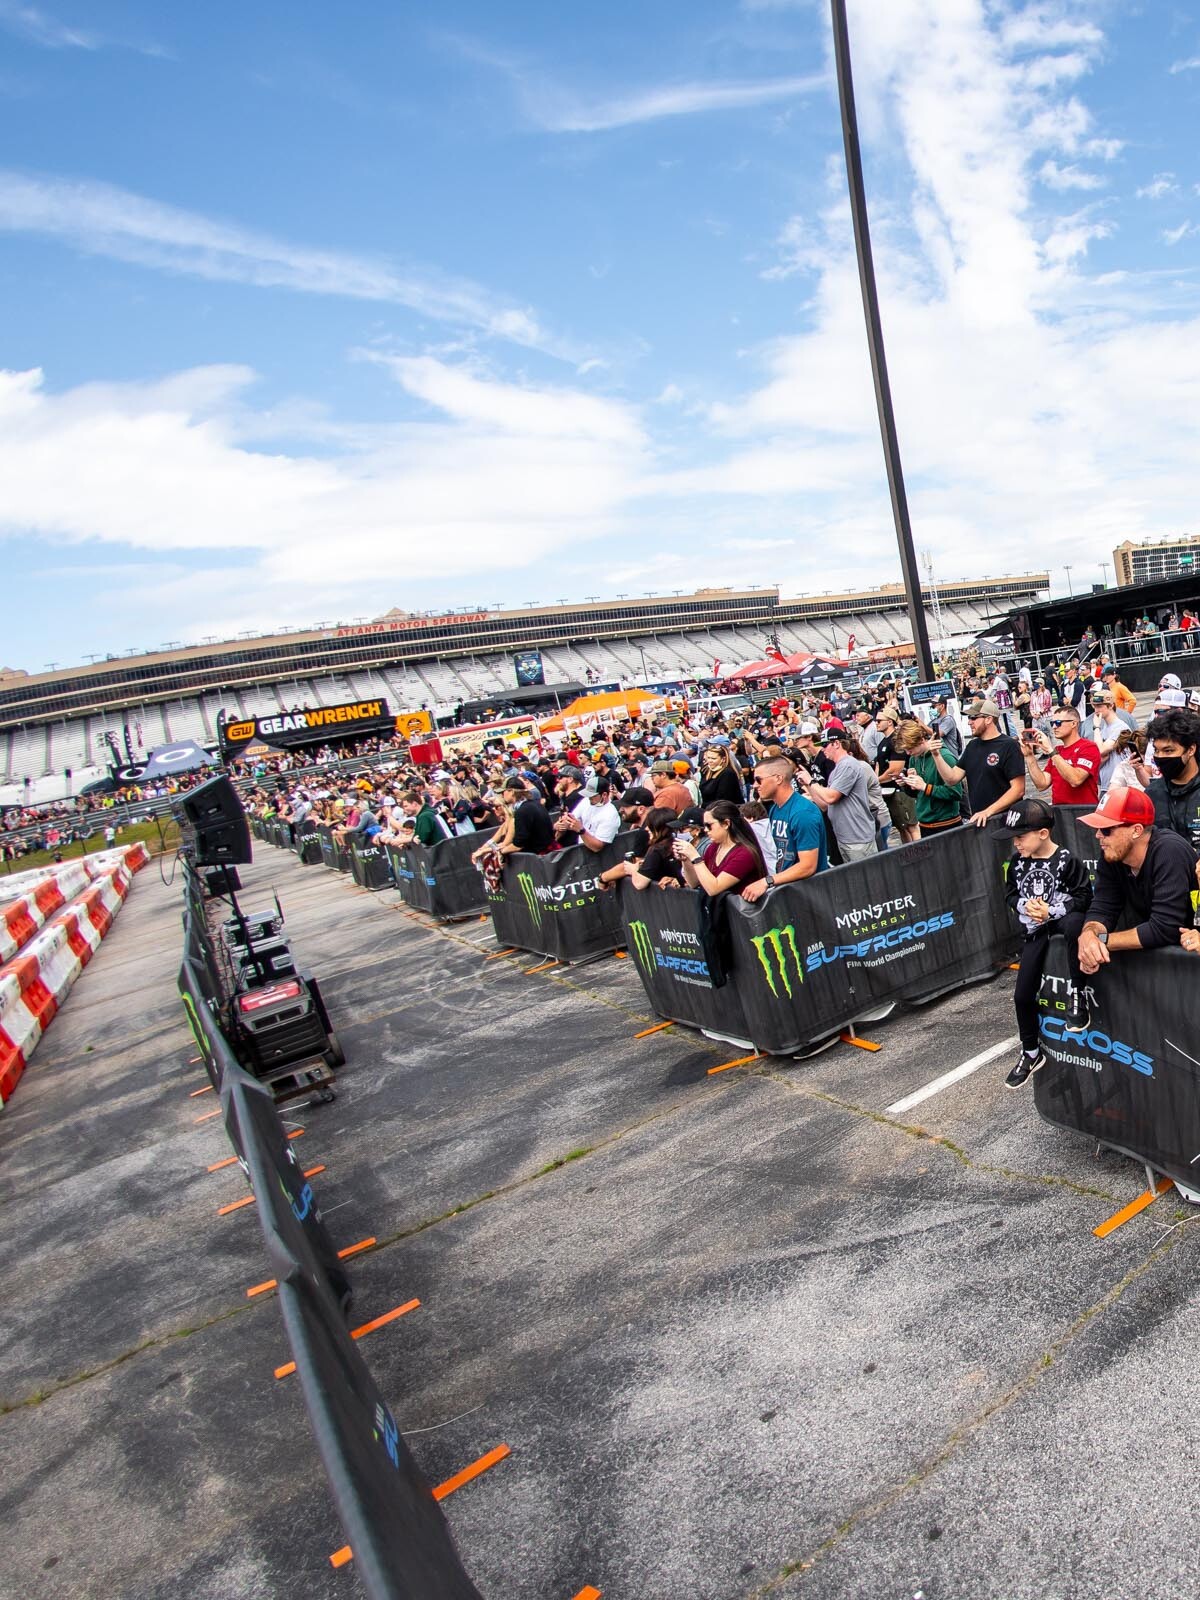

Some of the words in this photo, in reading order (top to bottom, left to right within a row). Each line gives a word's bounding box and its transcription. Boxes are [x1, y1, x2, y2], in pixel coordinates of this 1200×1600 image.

[337, 624, 385, 637] ATLANTA
[390, 620, 428, 631] MOTOR
[432, 613, 488, 626] SPEEDWAY
[913, 686, 930, 694] PLEASE
[930, 683, 949, 692] PRACTICE
[258, 701, 382, 735] GEARWRENCH
[771, 819, 789, 838] FOX
[543, 896, 597, 912] ENERGY
[835, 894, 916, 929] MONSTER
[852, 913, 907, 937] ENERGY
[659, 928, 700, 947] MONSTER
[806, 911, 955, 974] SUPERCROSS
[807, 941, 825, 955] AMA
[669, 945, 697, 955] ENERGY
[847, 960, 862, 969] FIM
[862, 951, 884, 968] World
[882, 942, 926, 963] Championship
